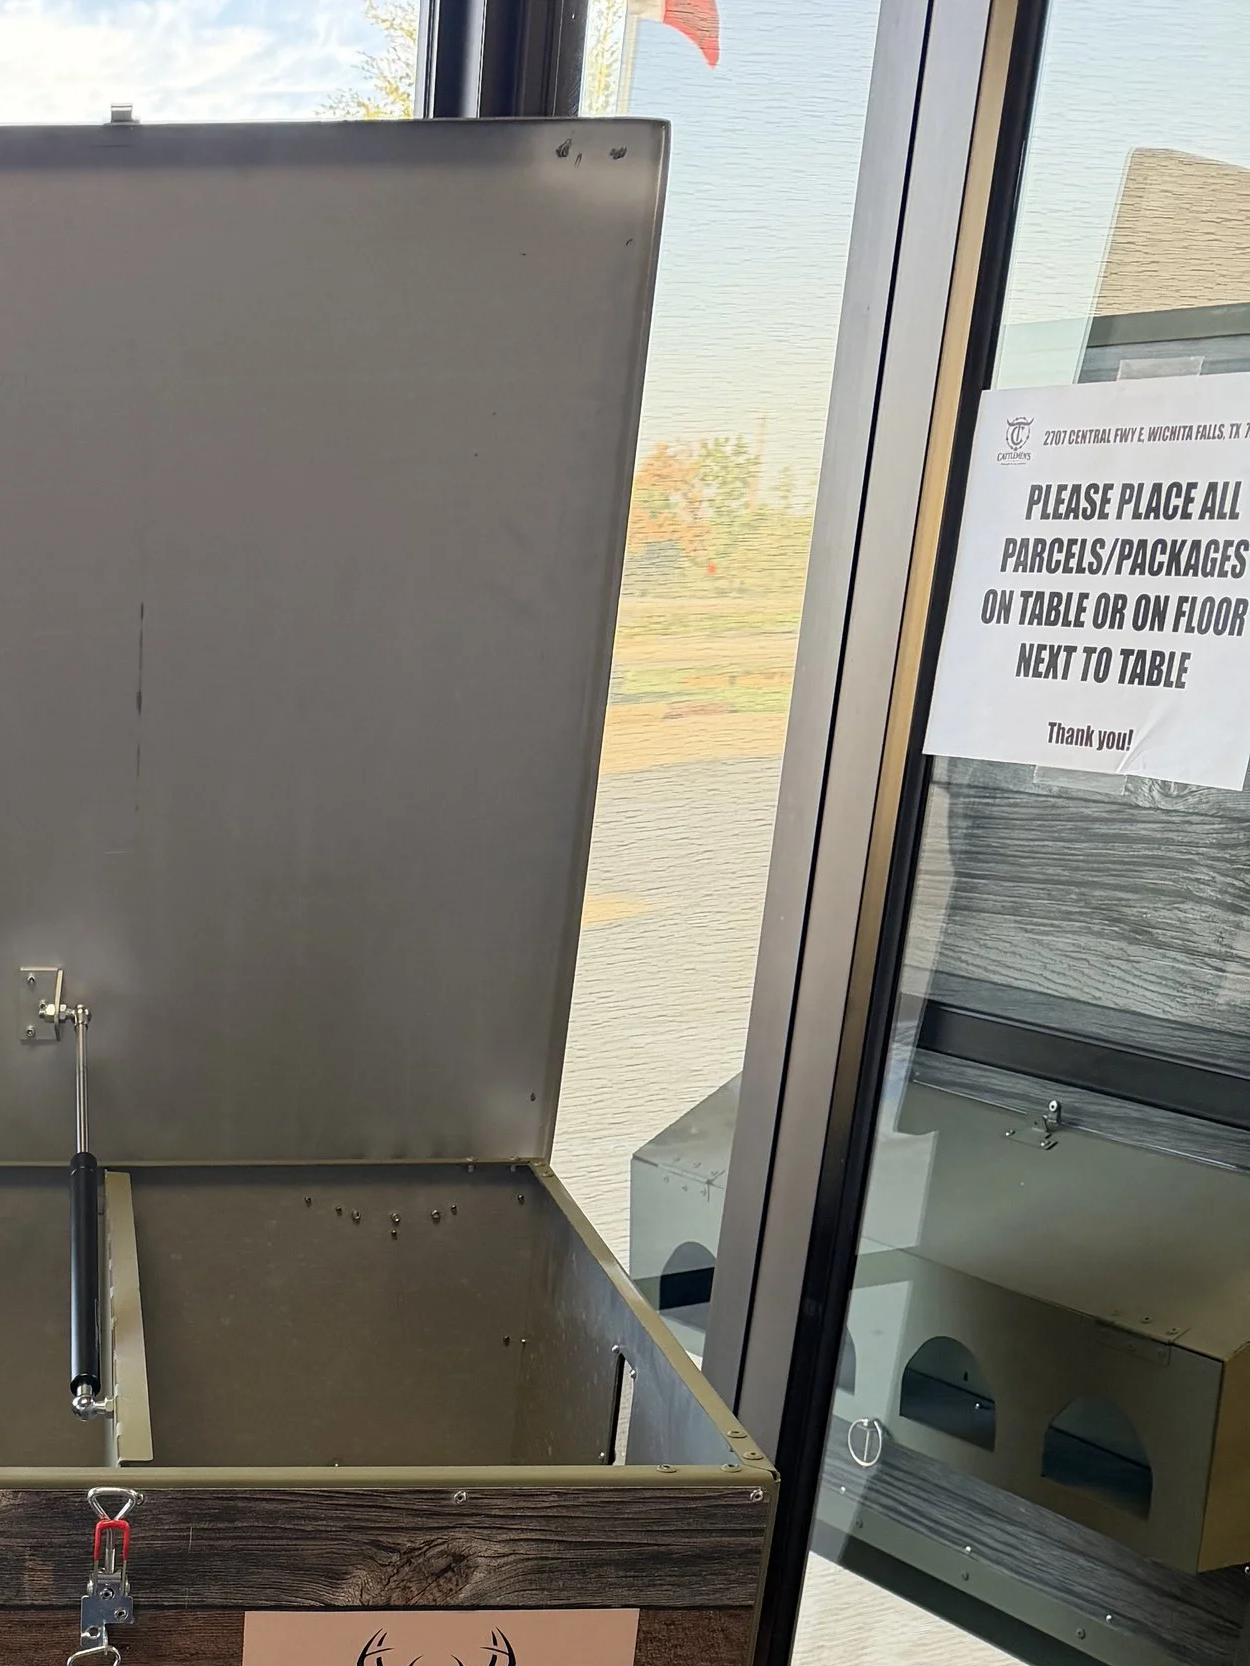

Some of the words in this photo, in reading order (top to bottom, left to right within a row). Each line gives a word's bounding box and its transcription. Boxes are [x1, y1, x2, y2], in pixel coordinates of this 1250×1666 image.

[1043, 430, 1067, 446] 2707
[1068, 428, 1112, 445] CENTRAL
[1113, 427, 1137, 443] FWY
[1147, 424, 1193, 442] WICHITA
[1194, 423, 1226, 441] FALLS,
[1228, 422, 1242, 439] TX
[1025, 482, 1114, 521] PLEASE
[1115, 481, 1198, 521] PLACE
[1198, 481, 1242, 520] ALL
[1000, 537, 1250, 579] PARCELS/PACKAGES
[981, 589, 1015, 625] ON
[1018, 591, 1090, 628] TABLE
[1092, 592, 1128, 630] OR
[1132, 594, 1170, 632] ON
[1172, 595, 1249, 636] FLOOR
[1015, 643, 1078, 679] NEXT
[1081, 647, 1113, 684] TO
[1118, 648, 1192, 689] TABLE
[1047, 721, 1095, 748] Thank
[1096, 729, 1134, 752] you!
